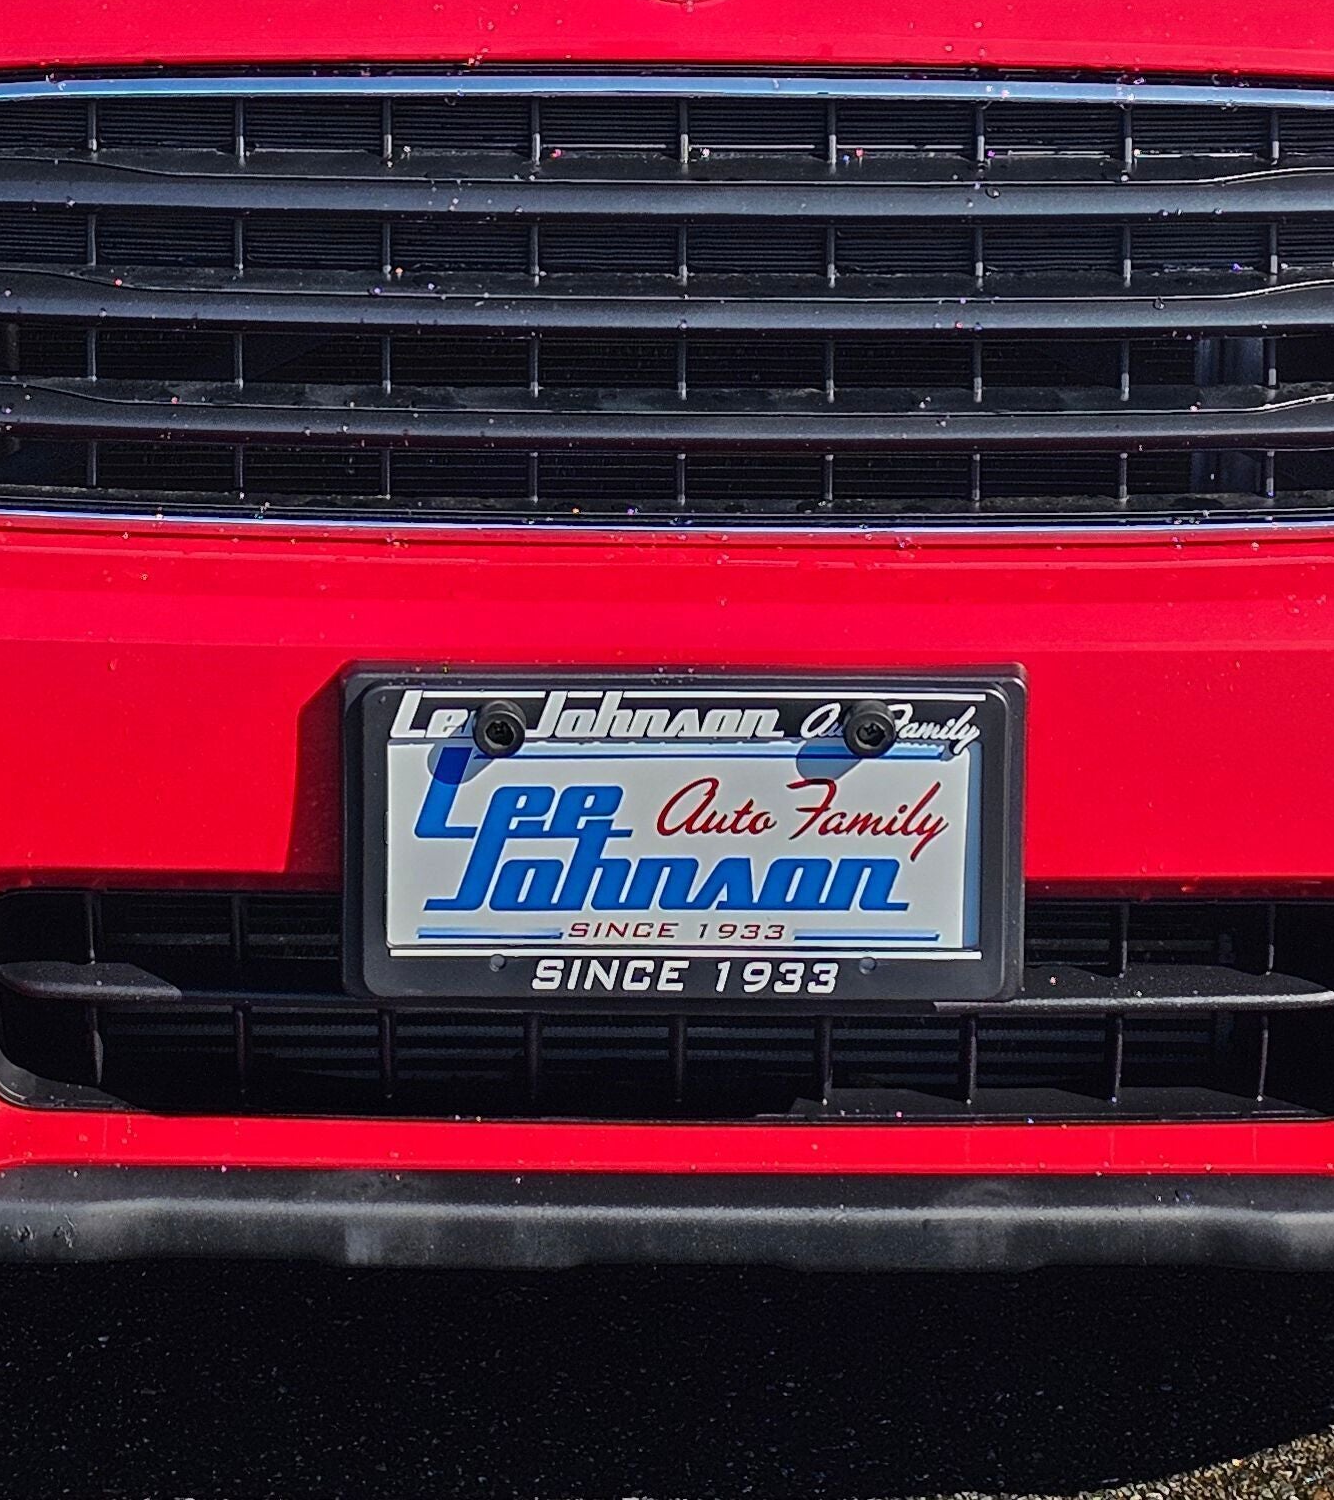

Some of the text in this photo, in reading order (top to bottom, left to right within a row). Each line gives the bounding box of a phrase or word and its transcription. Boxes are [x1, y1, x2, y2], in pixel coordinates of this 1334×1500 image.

[389, 689, 478, 738] Le
[523, 690, 785, 739] Johnson
[414, 746, 633, 839] Lee
[656, 777, 949, 862] Auto Family
[424, 825, 910, 912] Johnson
[568, 922, 786, 940] SINCE 1933
[532, 958, 840, 994] SINCE 1933
